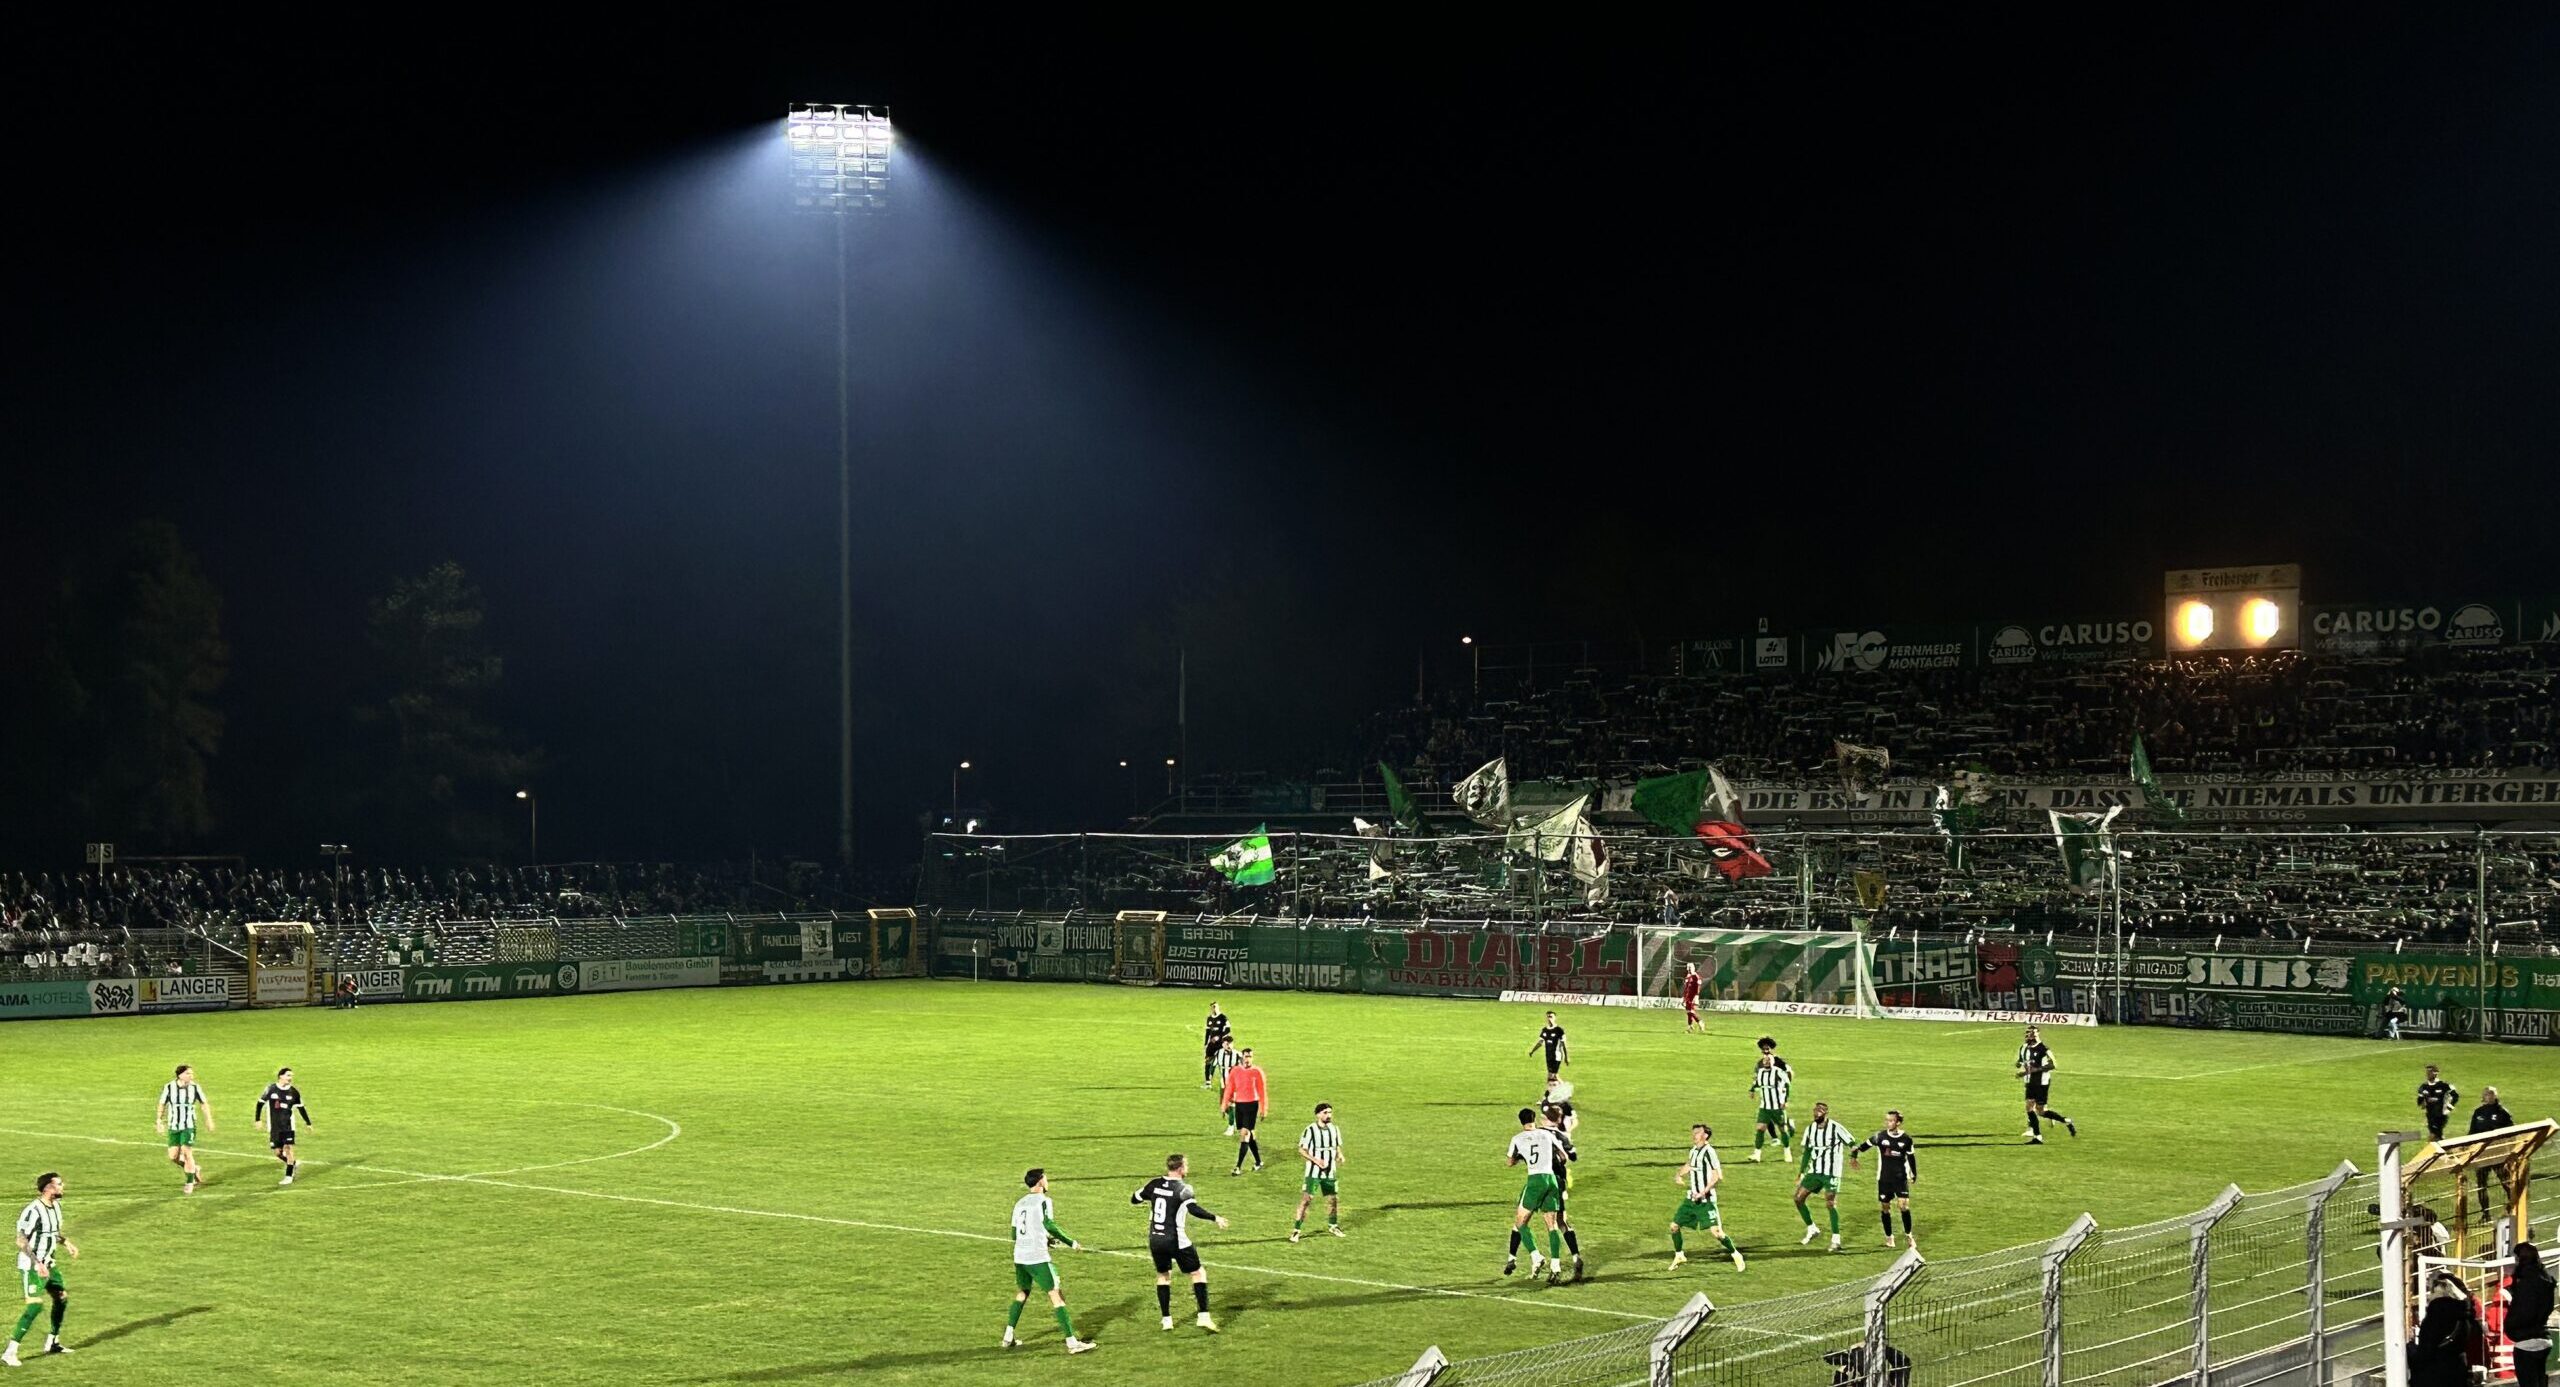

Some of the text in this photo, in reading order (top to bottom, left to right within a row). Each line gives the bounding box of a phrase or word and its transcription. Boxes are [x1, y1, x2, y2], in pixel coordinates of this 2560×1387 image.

[2313, 606, 2441, 635] CARUSO
[2039, 621, 2153, 646] CARUSO
[2445, 627, 2504, 639] CARUSO
[1890, 643, 1962, 657] FERNMELDE
[1988, 647, 2036, 658] CARUSO
[1759, 655, 1785, 664] LOTTO
[1888, 656, 1960, 669] MONTAGEN
[1749, 792, 1798, 810] DIE
[2051, 789, 2131, 808] DASS
[2208, 786, 2356, 807] NIEMALS
[997, 925, 1034, 948] SPORTS
[685, 958, 713, 969] GmbH
[1165, 965, 1224, 981] KOMBINAT
[160, 978, 225, 995] LANGER
[415, 979, 453, 995] TTM
[465, 976, 501, 993] TTM
[515, 973, 551, 991] TTM
[1986, 1011, 2070, 1024] FLEX TRANS
[1529, 1144, 1539, 1166] 5
[1153, 1197, 1167, 1223] 9
[1019, 1209, 1028, 1235] 3
